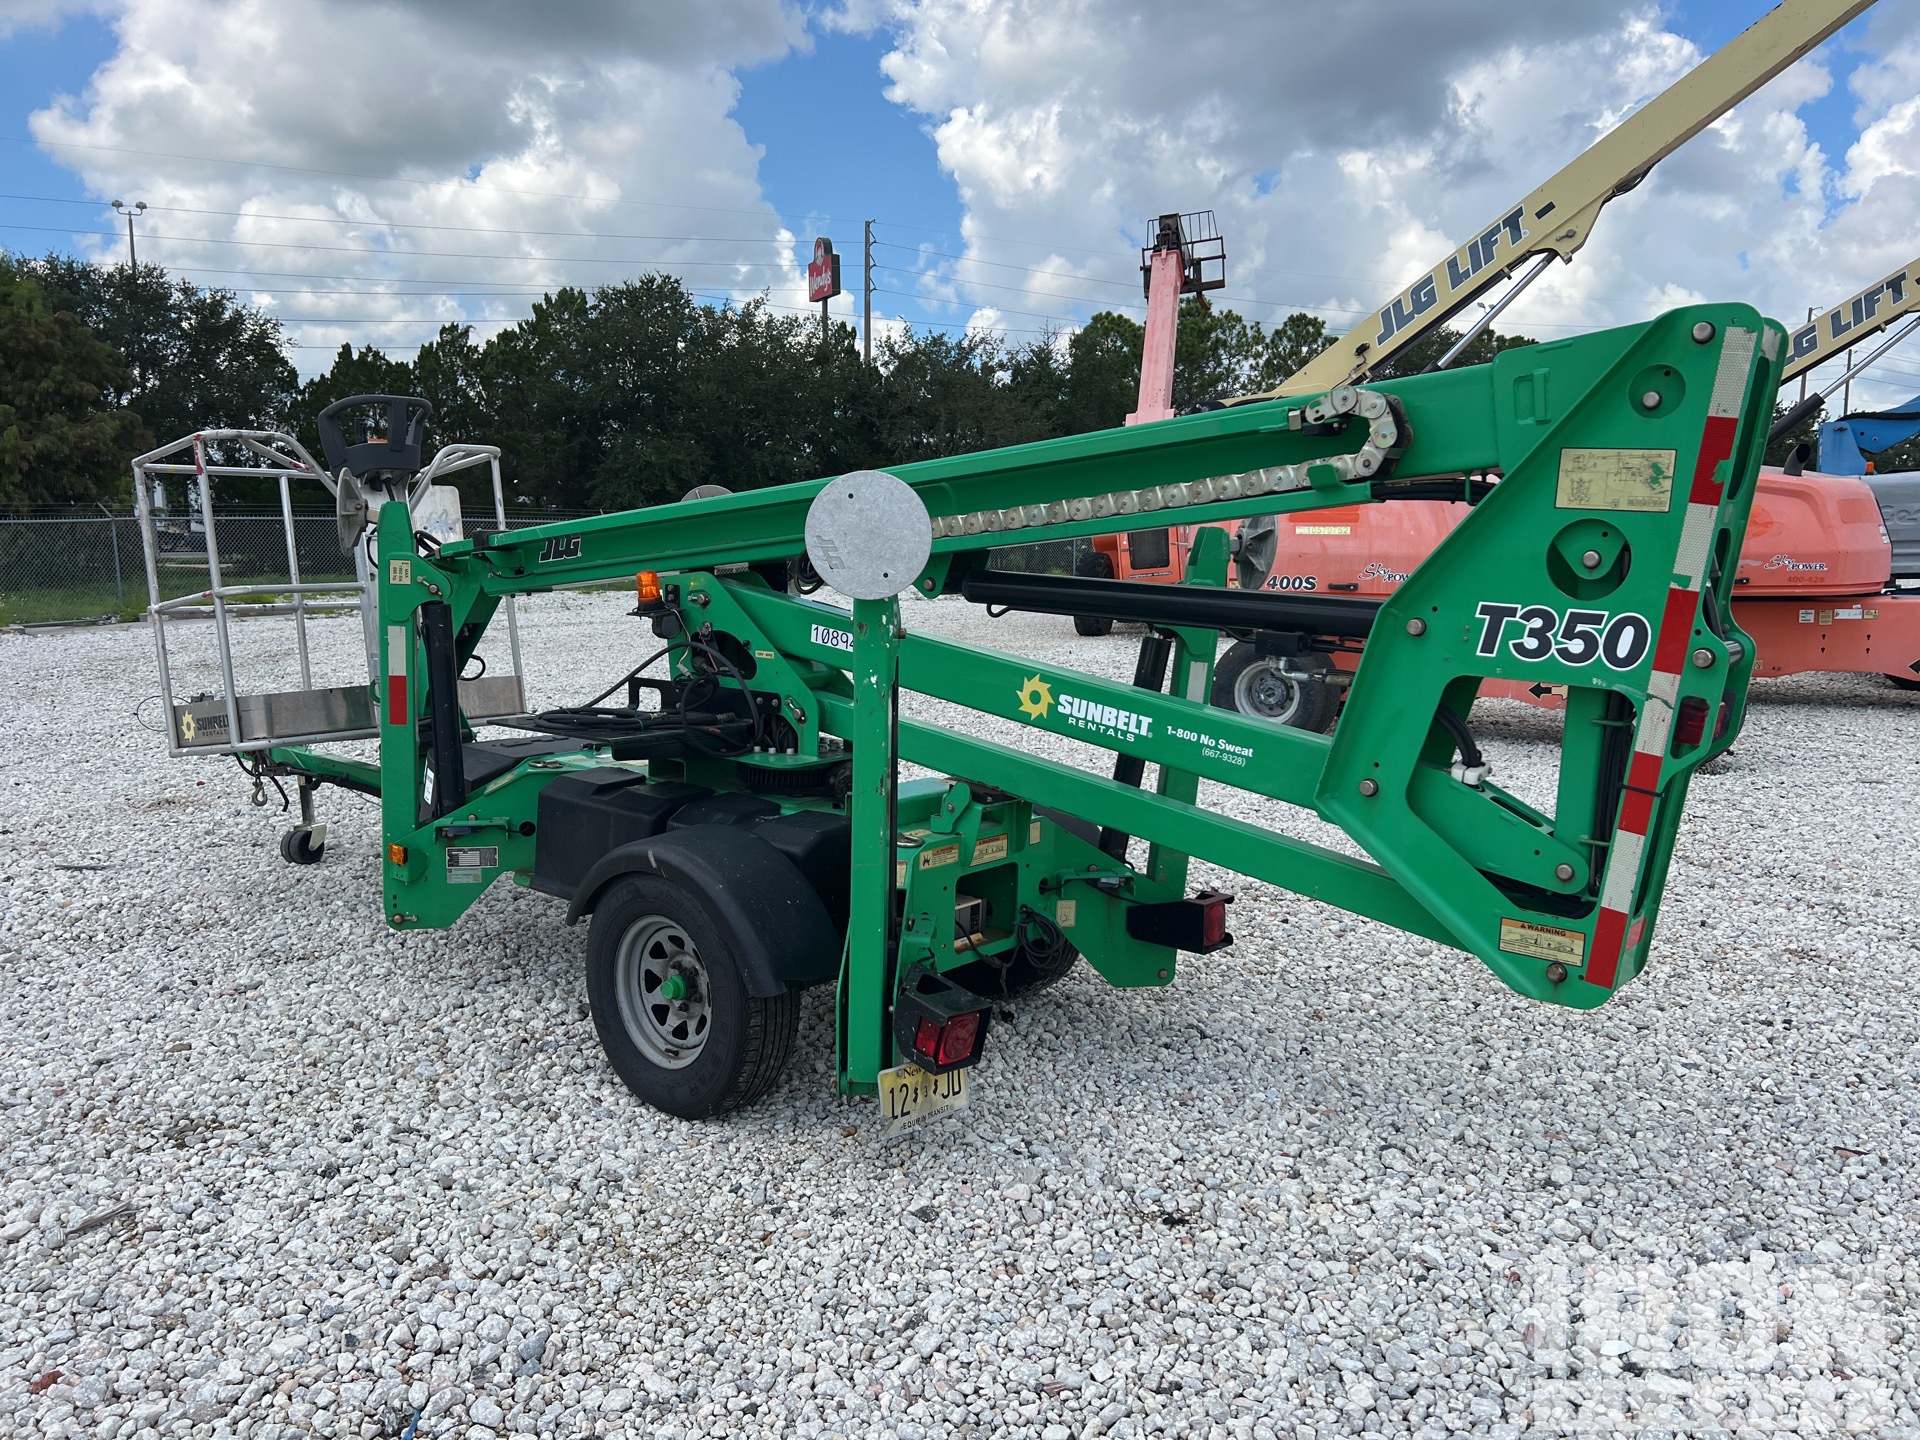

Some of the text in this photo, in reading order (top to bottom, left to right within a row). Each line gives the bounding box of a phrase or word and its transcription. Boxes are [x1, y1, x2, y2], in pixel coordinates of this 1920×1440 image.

[1376, 204, 1525, 348] JLG LIFT
[1829, 269, 1908, 341] LIFT
[539, 533, 581, 563] JLG
[1266, 575, 1318, 592] 400S
[1475, 601, 1652, 672] T350
[1057, 693, 1153, 737] SUNBELT
[1068, 717, 1136, 743] RENTALS
[1166, 725, 1254, 758] 1-800 No Sweat
[1202, 747, 1247, 767] (667-9328)
[1527, 923, 1567, 937] WARNING
